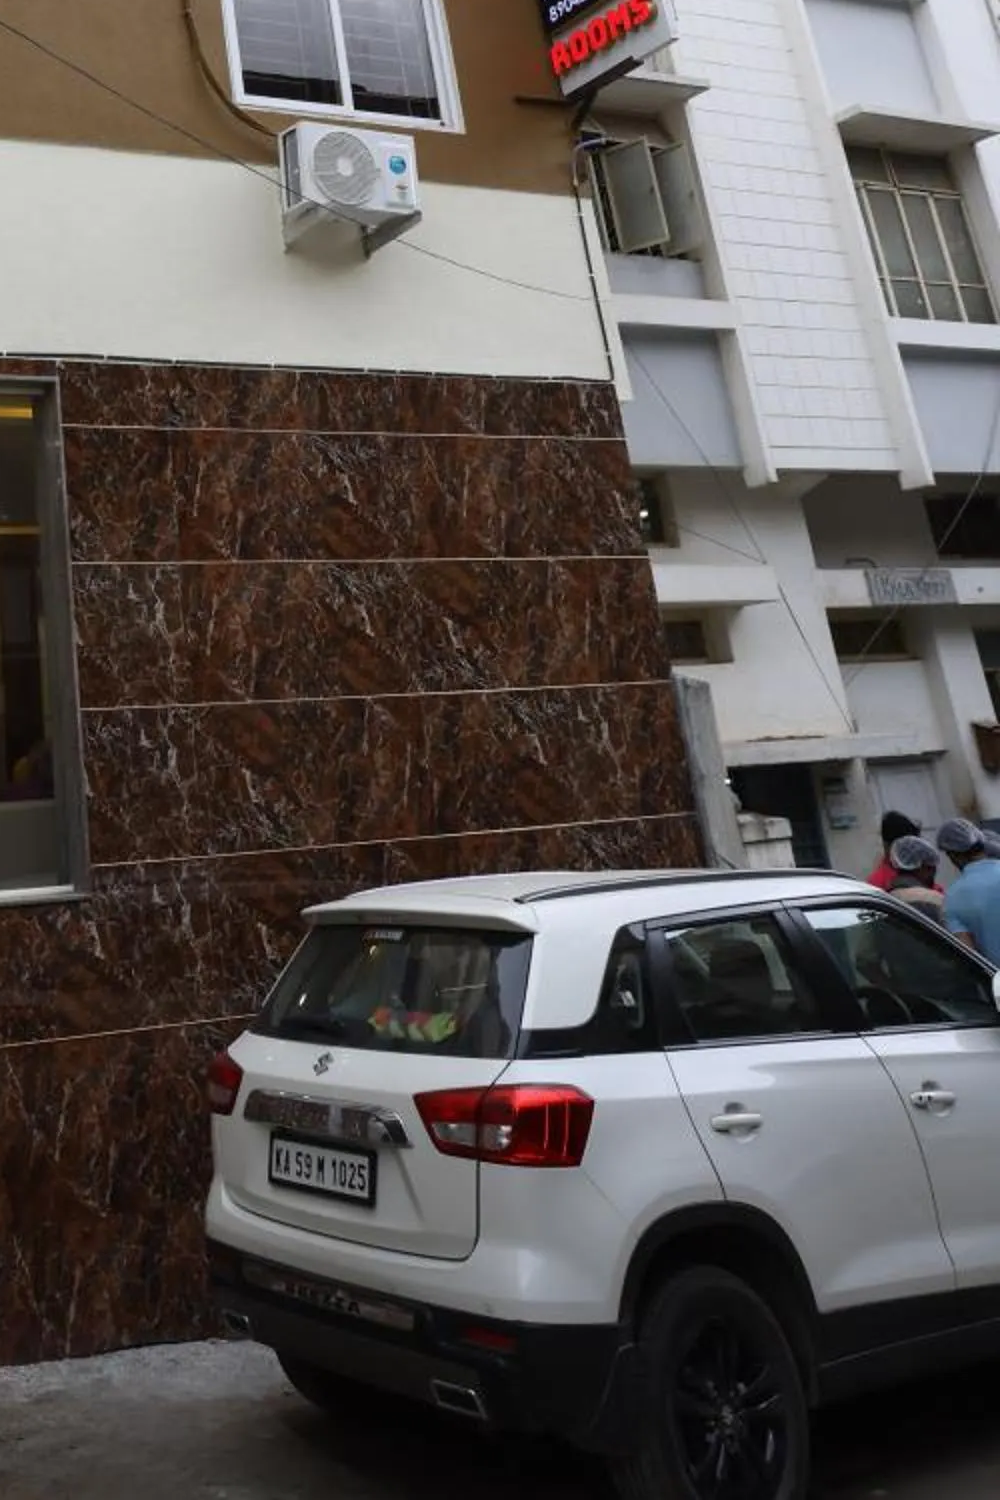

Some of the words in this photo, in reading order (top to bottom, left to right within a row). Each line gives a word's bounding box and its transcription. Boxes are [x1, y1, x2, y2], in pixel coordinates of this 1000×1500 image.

[275, 1146, 291, 1176] KA
[295, 1151, 313, 1180] 59
[332, 1156, 367, 1191] 1025
